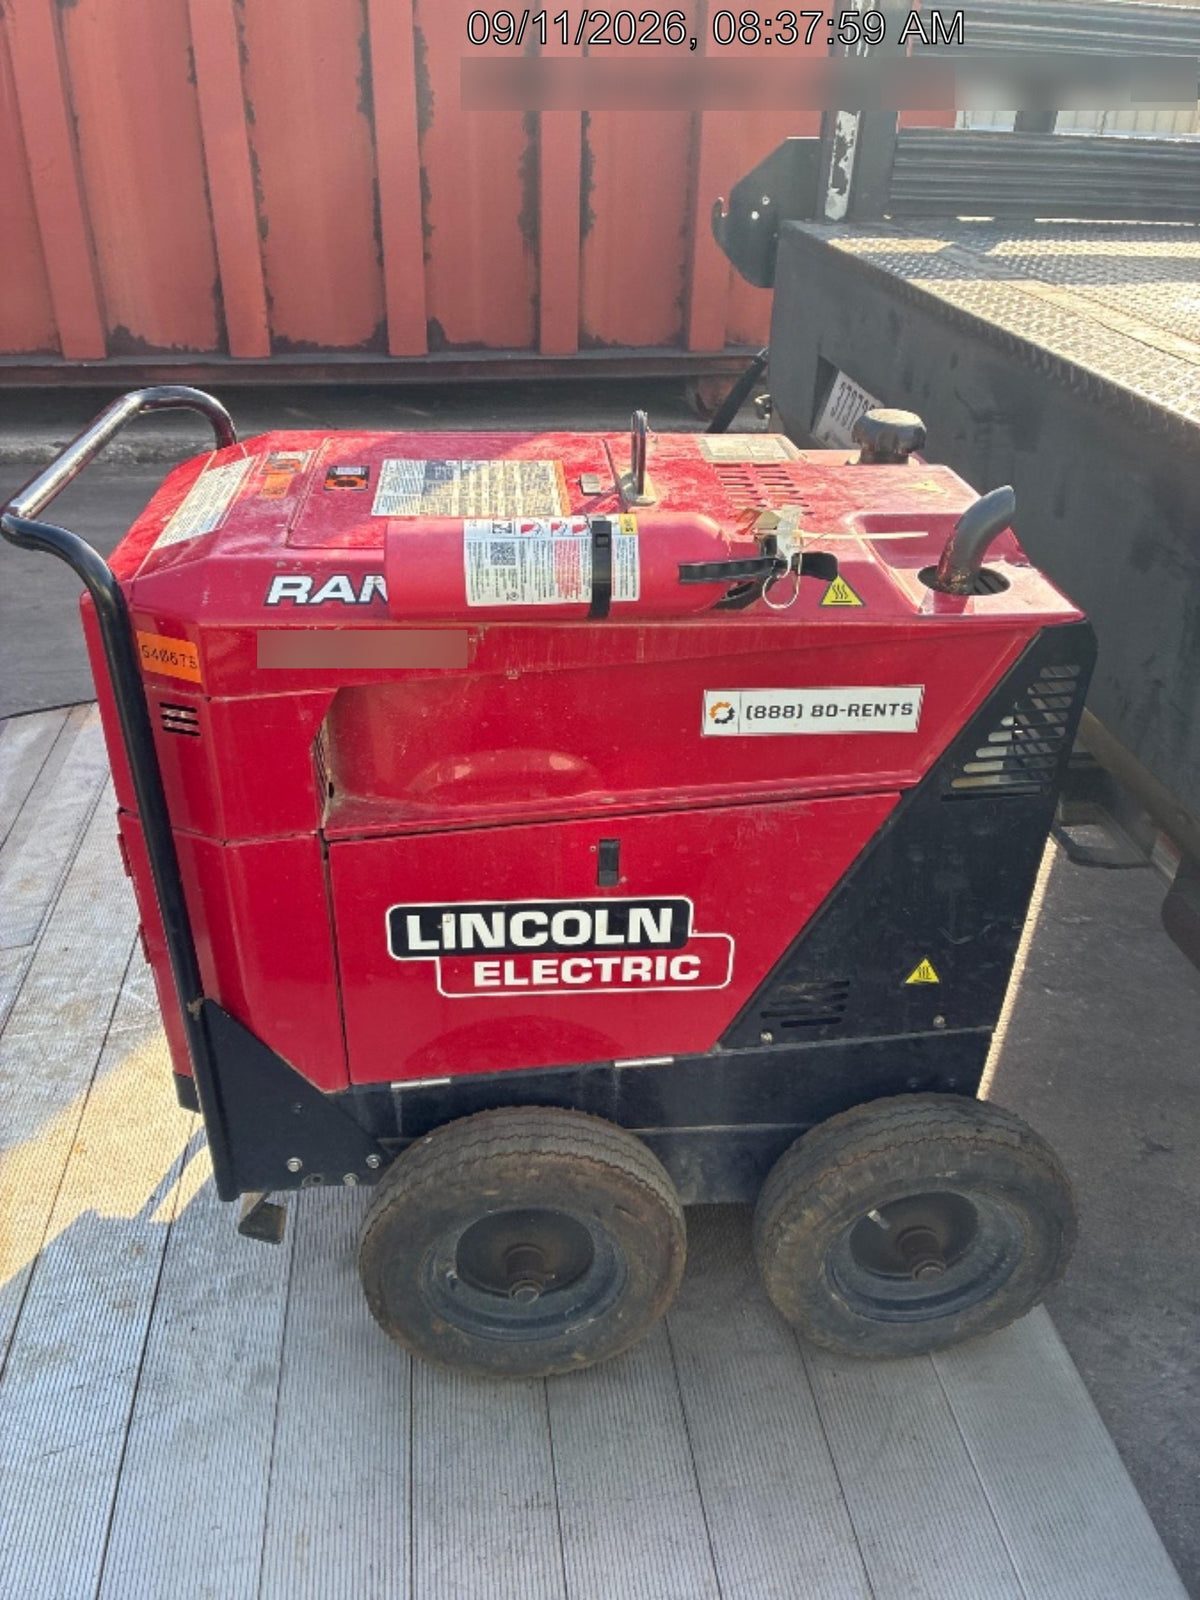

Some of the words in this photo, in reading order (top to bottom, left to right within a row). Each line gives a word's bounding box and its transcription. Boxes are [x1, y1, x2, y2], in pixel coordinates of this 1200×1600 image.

[745, 704, 804, 721] (888)
[809, 702, 914, 718] 80-RENTS
[405, 907, 674, 951] LINCOLN
[473, 955, 702, 988] ELECTRIC
